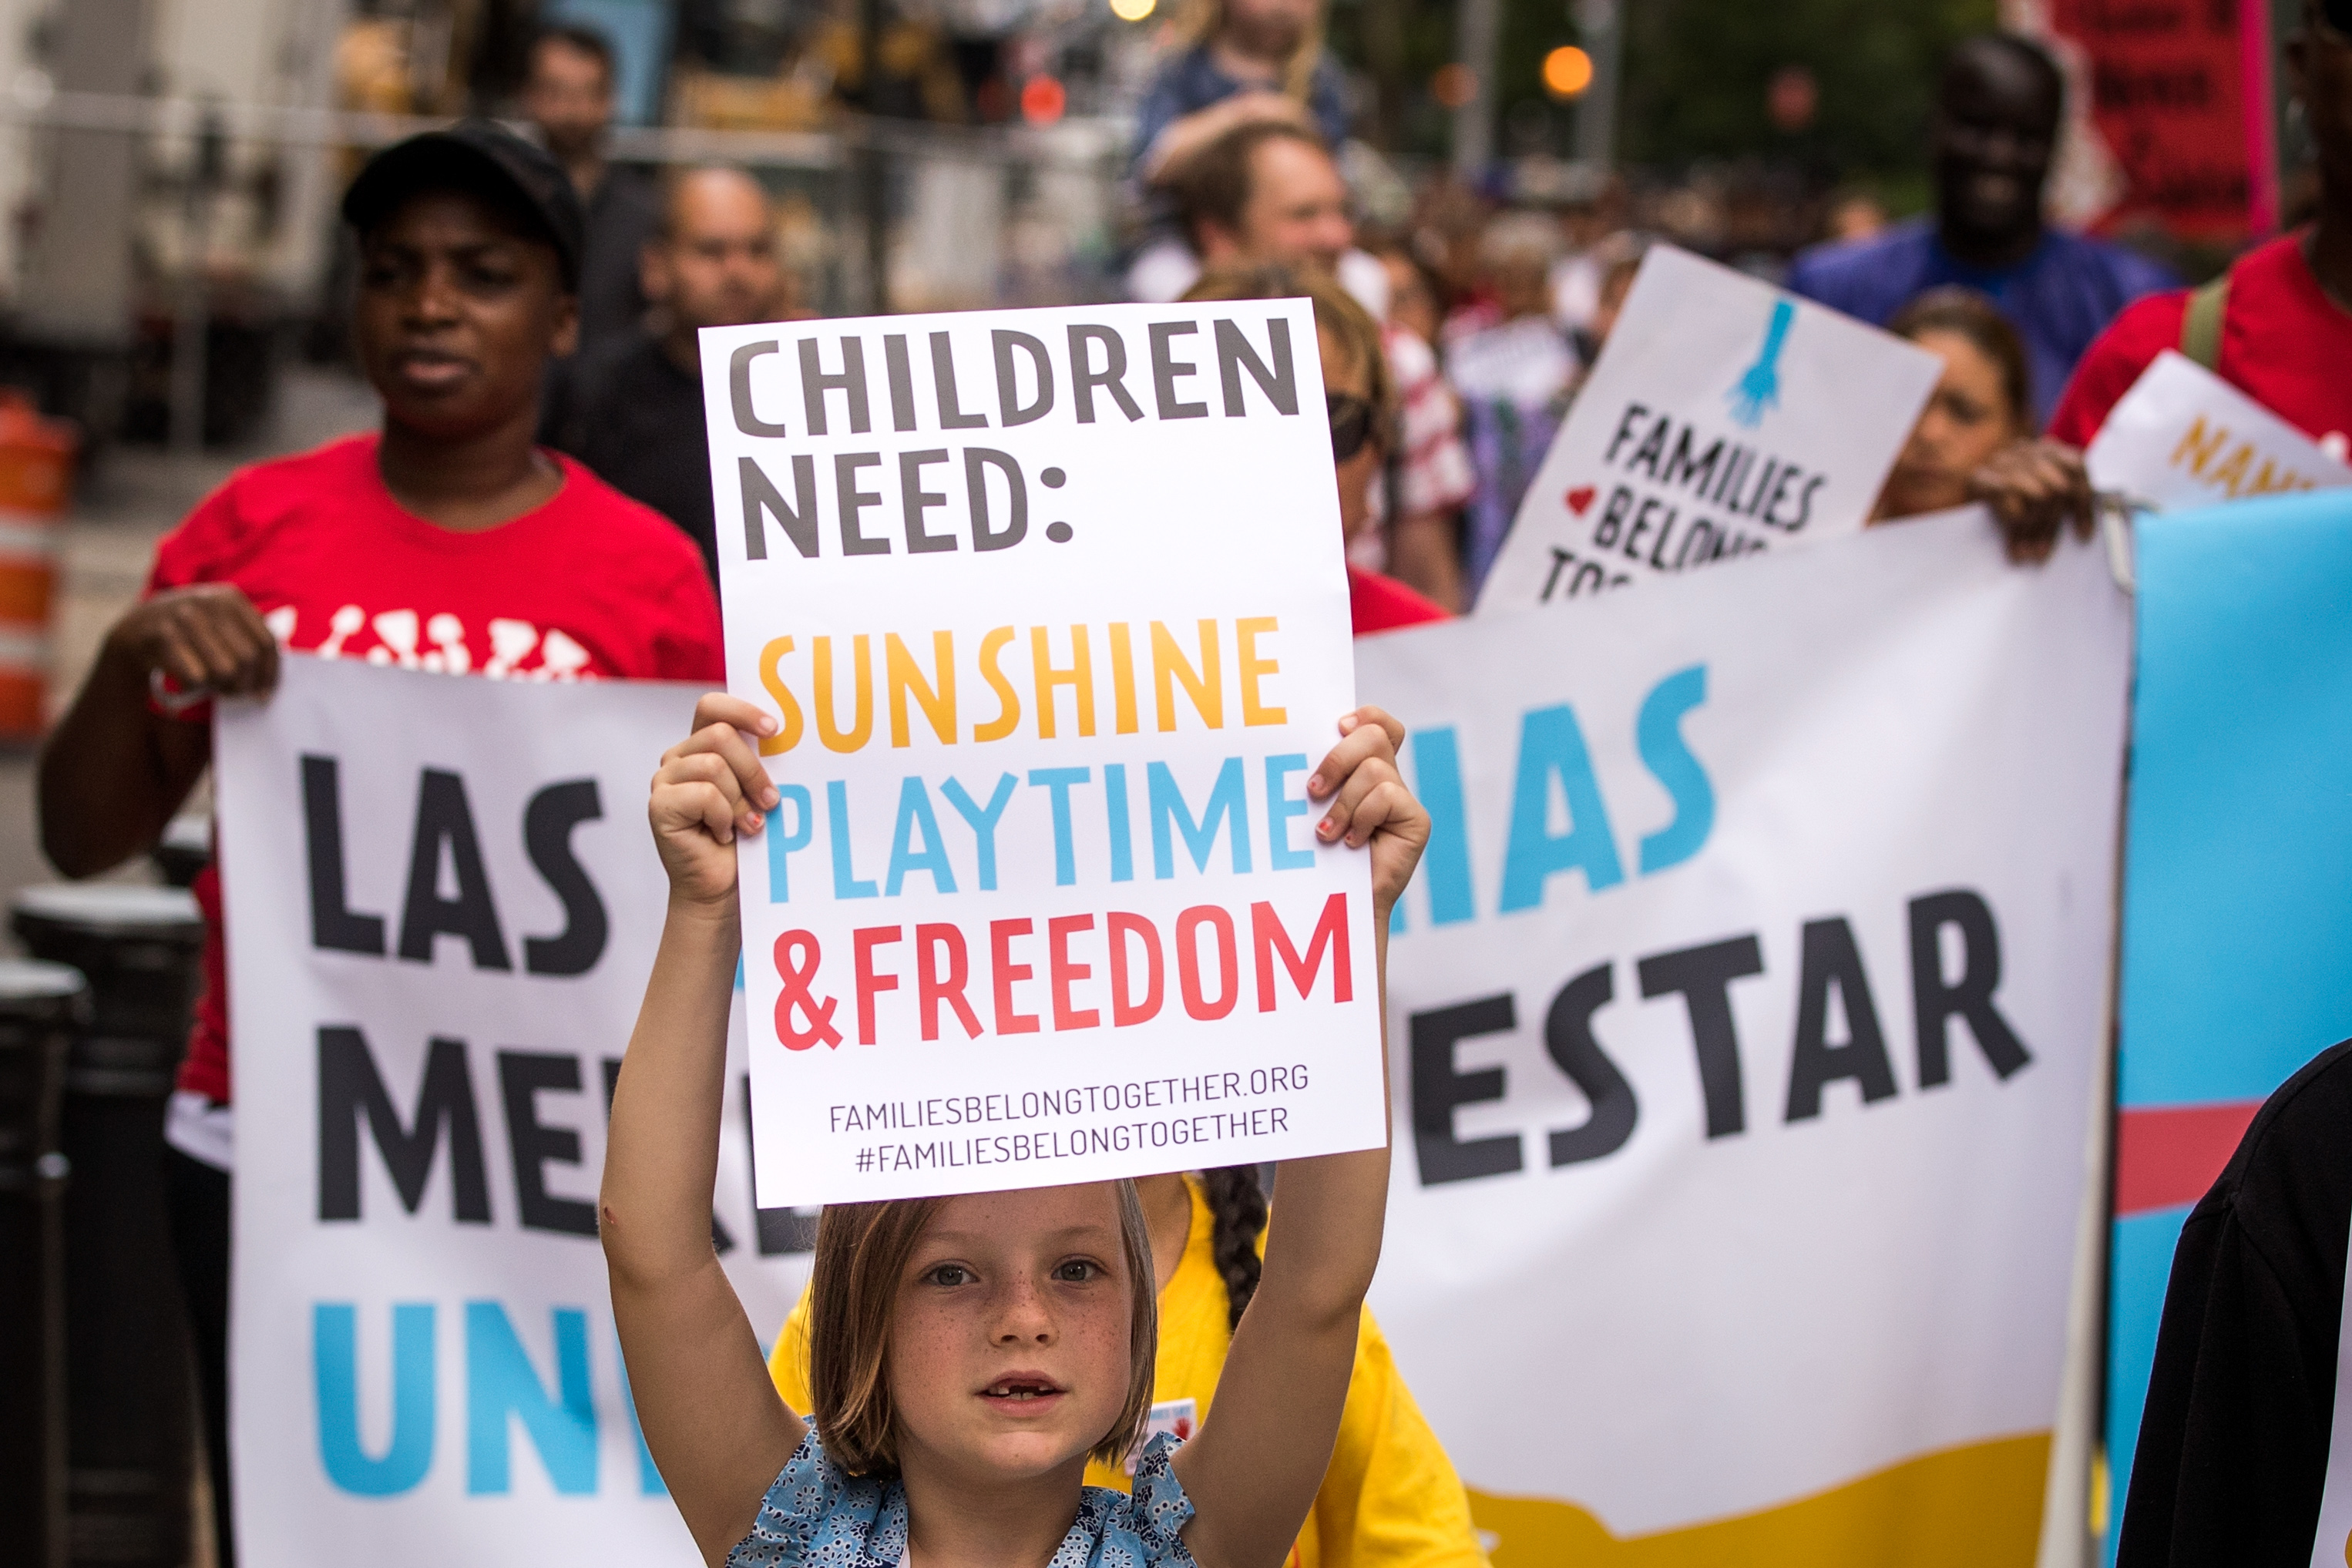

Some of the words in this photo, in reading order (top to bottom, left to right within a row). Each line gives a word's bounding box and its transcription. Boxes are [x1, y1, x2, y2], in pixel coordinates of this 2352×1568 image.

[730, 317, 1300, 438] CHILDREN
[738, 446, 1074, 561] NEED:
[1605, 401, 1825, 532] FAMILIES
[758, 616, 1289, 758] SUNSHINE
[299, 752, 610, 979] LAS
[766, 753, 1315, 904] PLAYTIME
[772, 891, 1354, 1051] &FREEDOM
[830, 1064, 1309, 1133] FAMILIESBELONGTOGETHER.ORG
[855, 1106, 1289, 1173] #FAMILIESBELONGTOGETHER
